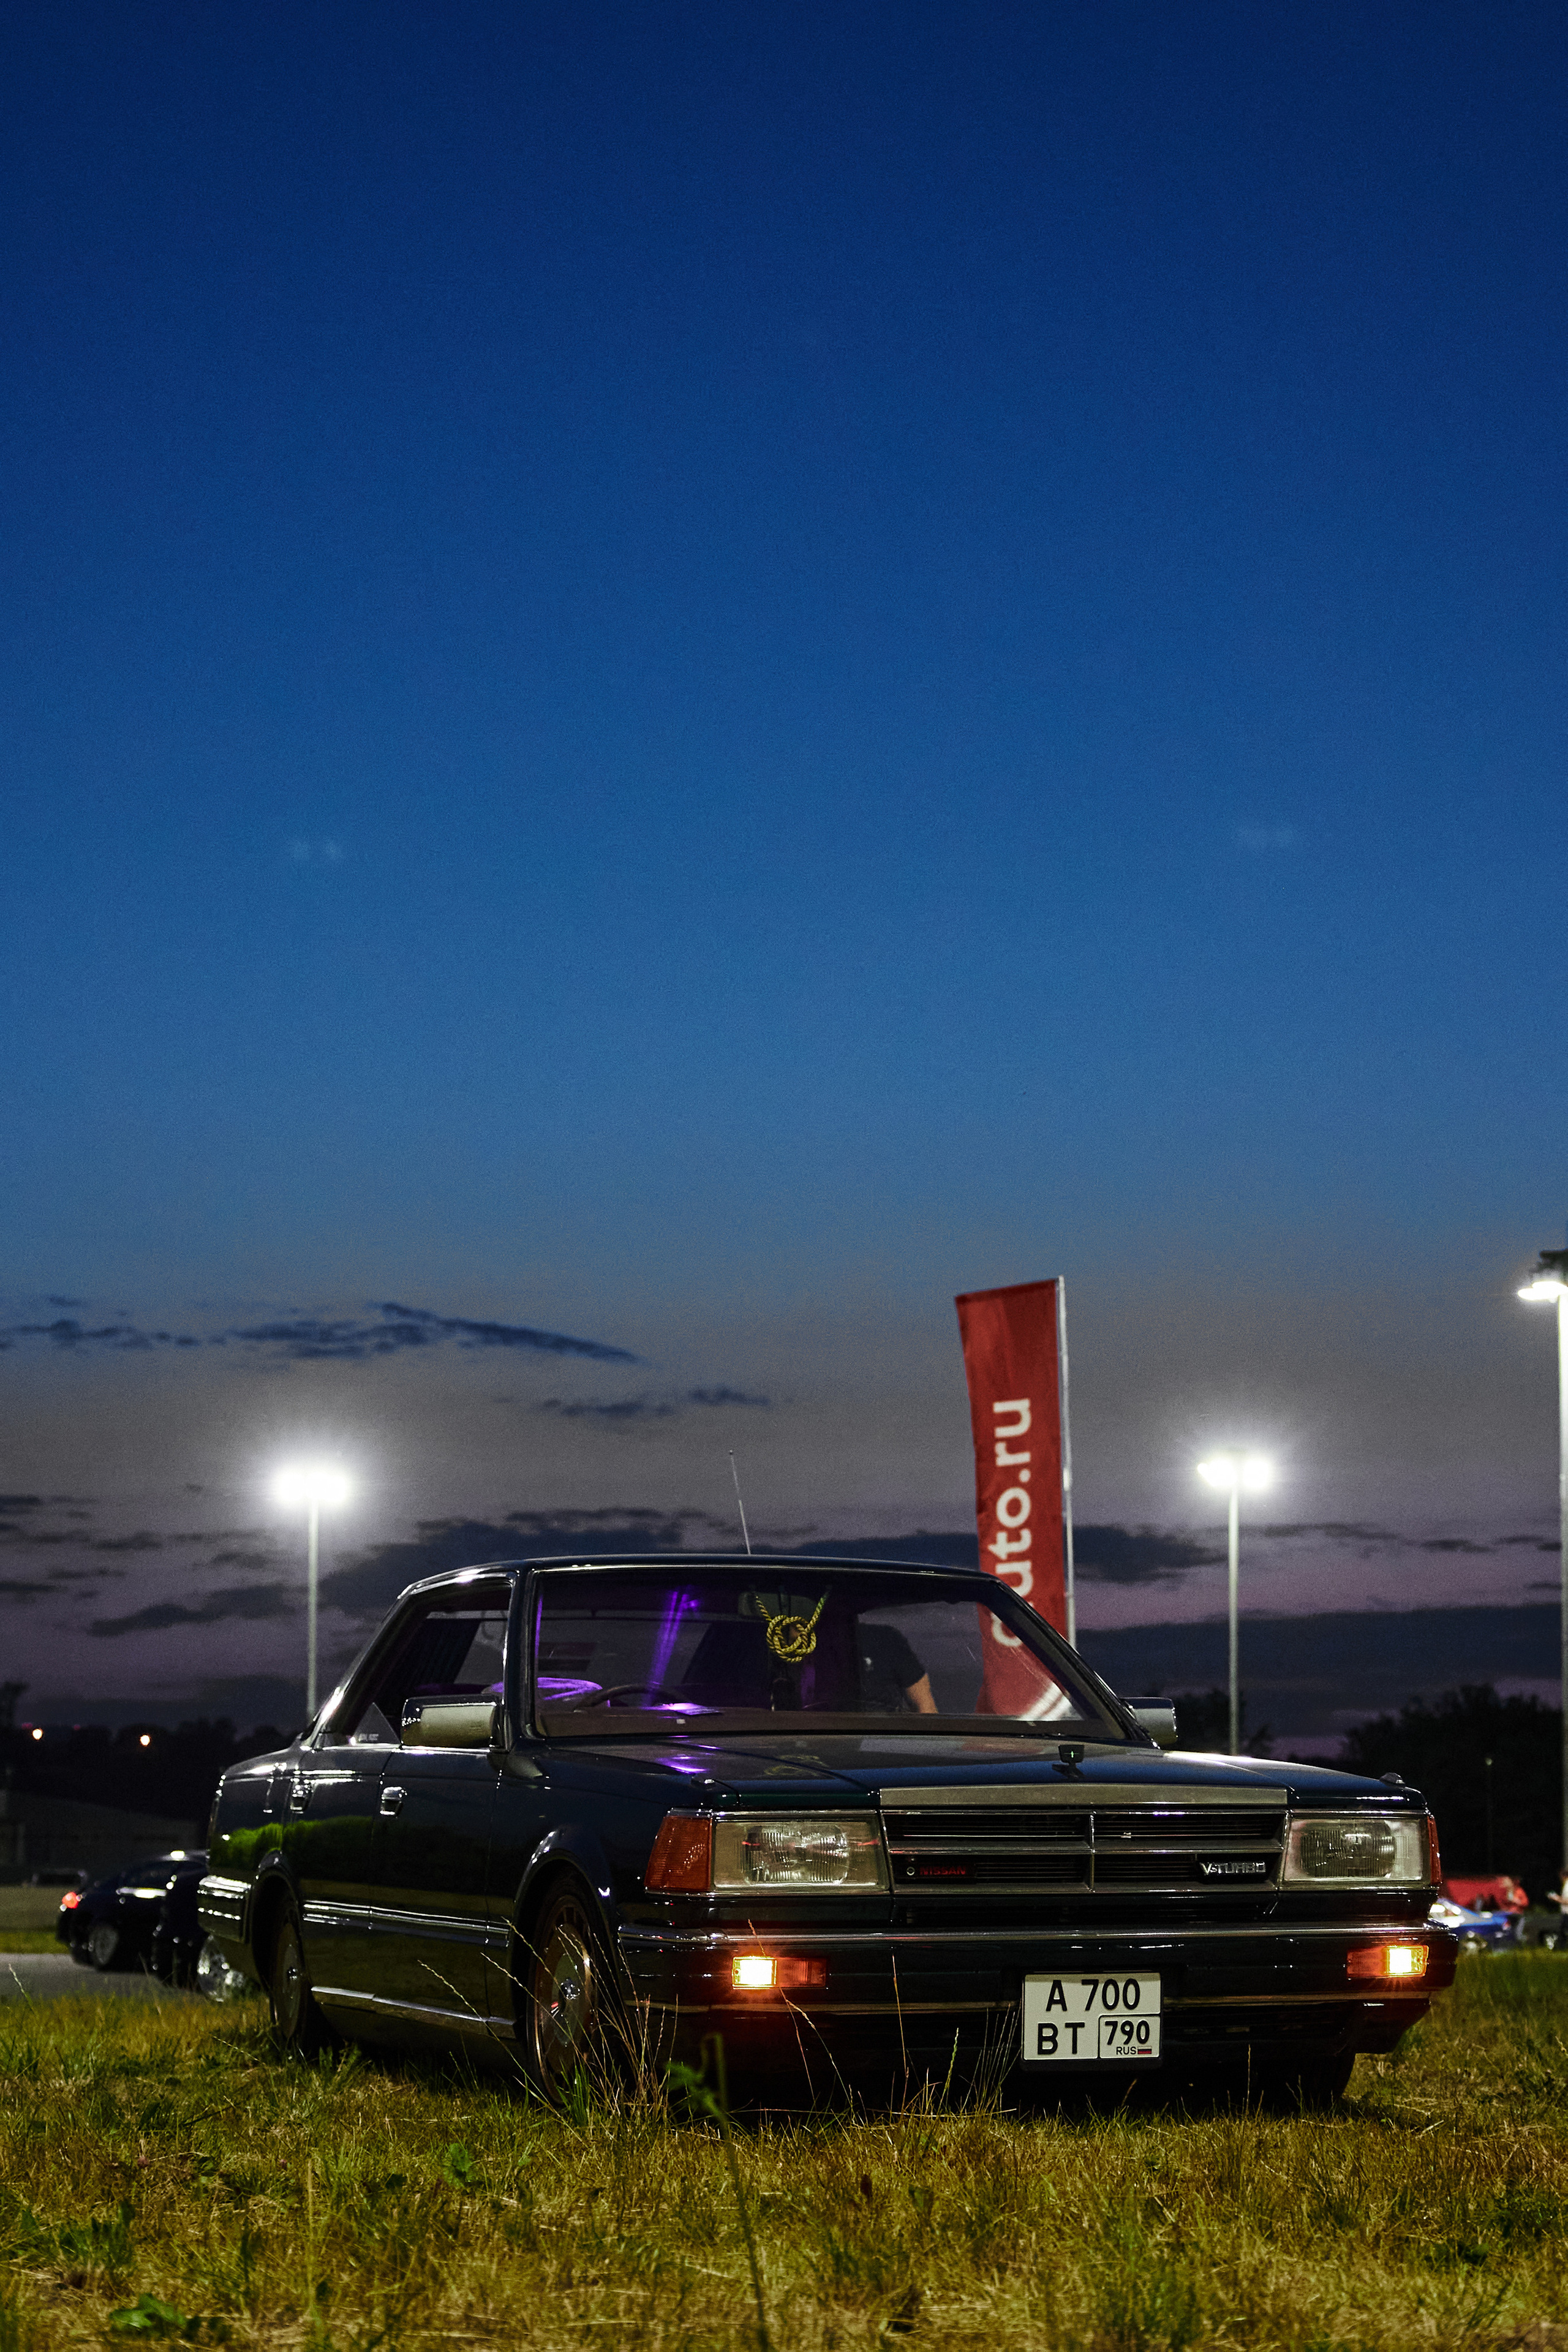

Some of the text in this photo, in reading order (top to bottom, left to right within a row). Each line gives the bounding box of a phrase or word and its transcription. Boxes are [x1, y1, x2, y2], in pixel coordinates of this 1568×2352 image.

[919, 1866, 967, 1875] NISSAN
[1046, 1978, 1140, 2011] A 700
[1037, 2022, 1085, 2055] BT
[1105, 2020, 1150, 2046] 790
[1116, 2046, 1137, 2055] RUS
